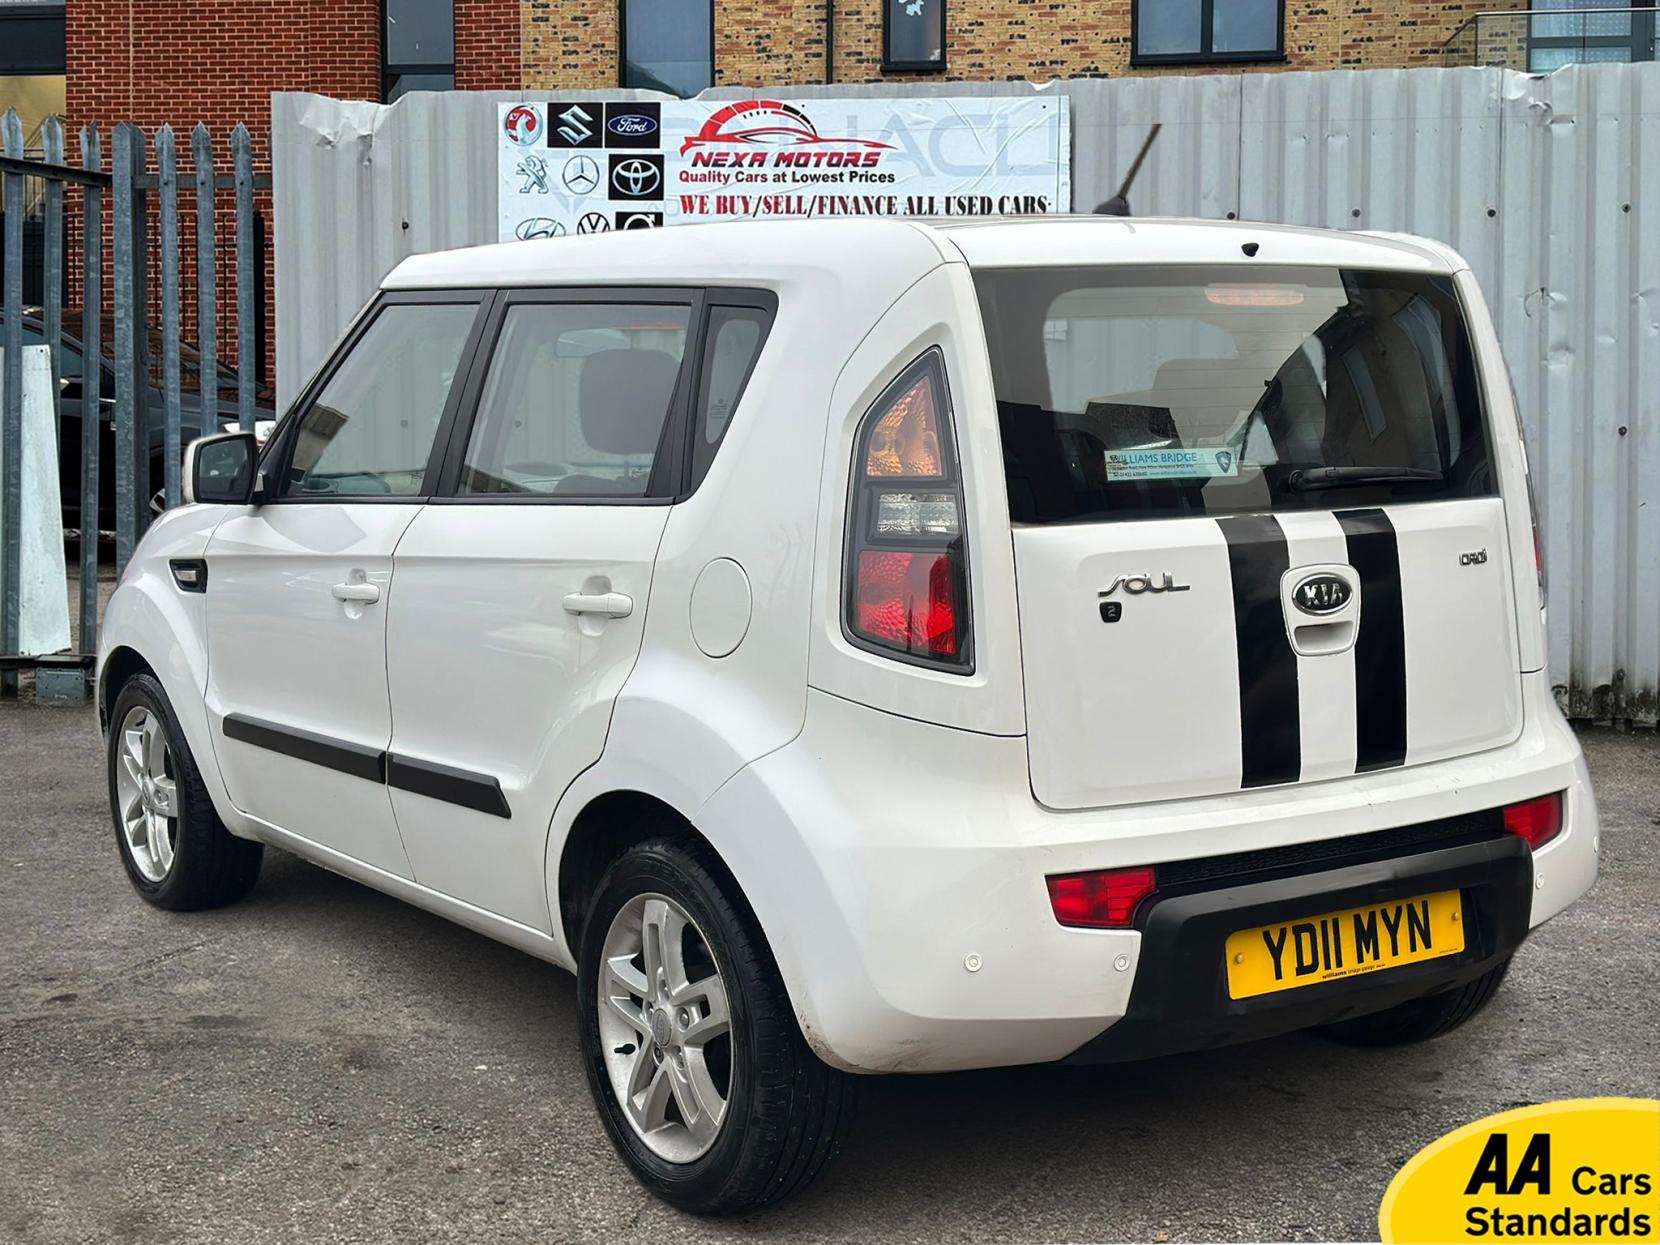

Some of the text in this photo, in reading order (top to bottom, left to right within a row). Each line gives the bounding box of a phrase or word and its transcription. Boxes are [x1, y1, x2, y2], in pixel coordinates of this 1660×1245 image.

[616, 116, 647, 132] Ford
[691, 151, 881, 168] NEXA MOTORS
[679, 170, 895, 186] Quality Cars at Lowest Prices
[679, 194, 710, 215] WE
[715, 194, 898, 217] BUY/SELL/FINANCE
[903, 195, 939, 216] ALL
[944, 195, 993, 216] USED
[998, 195, 1048, 216] CARS
[1161, 452, 1197, 463] BRIDGE
[1098, 571, 1190, 597] SOUL
[1303, 582, 1343, 606] KIA
[1262, 900, 1432, 981] YD11 MYN
